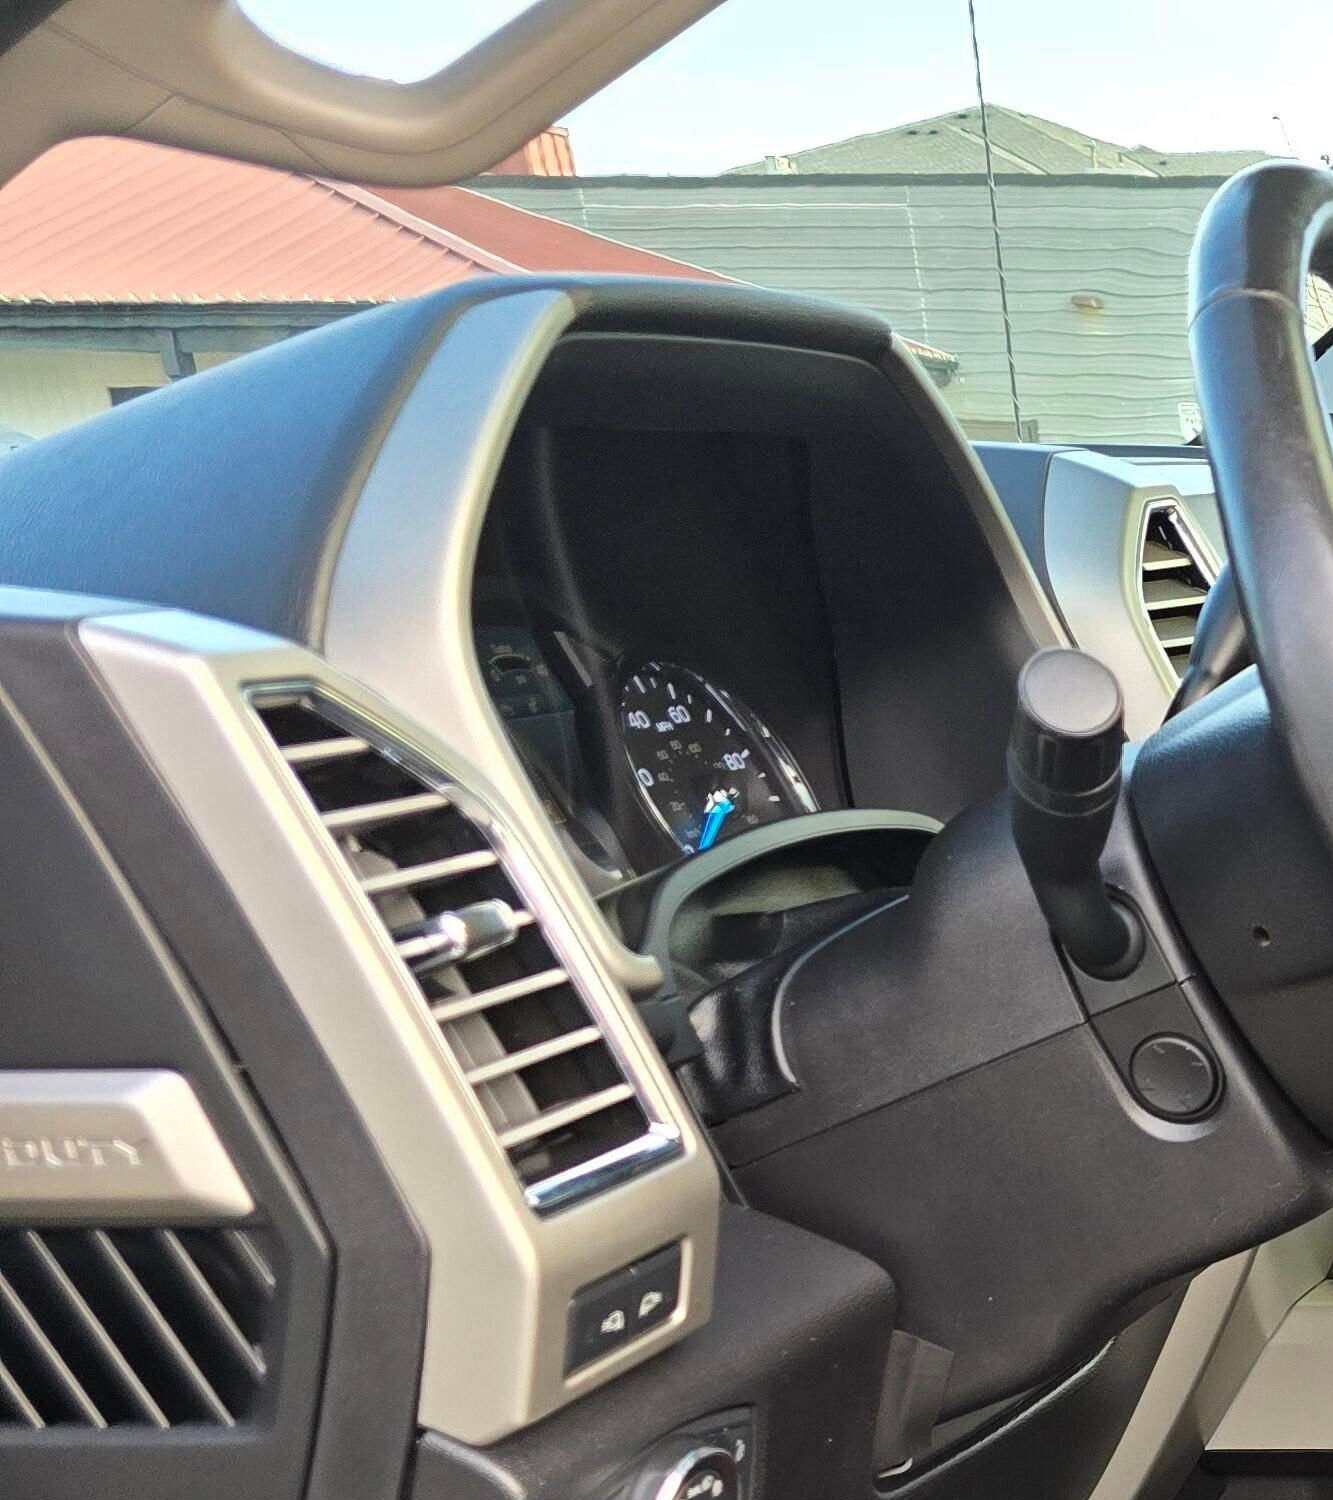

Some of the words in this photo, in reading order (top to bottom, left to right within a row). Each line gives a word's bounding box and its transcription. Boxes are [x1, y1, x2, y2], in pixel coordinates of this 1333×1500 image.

[628, 710, 651, 729] 40
[668, 704, 691, 724] 60
[723, 752, 745, 771] 80
